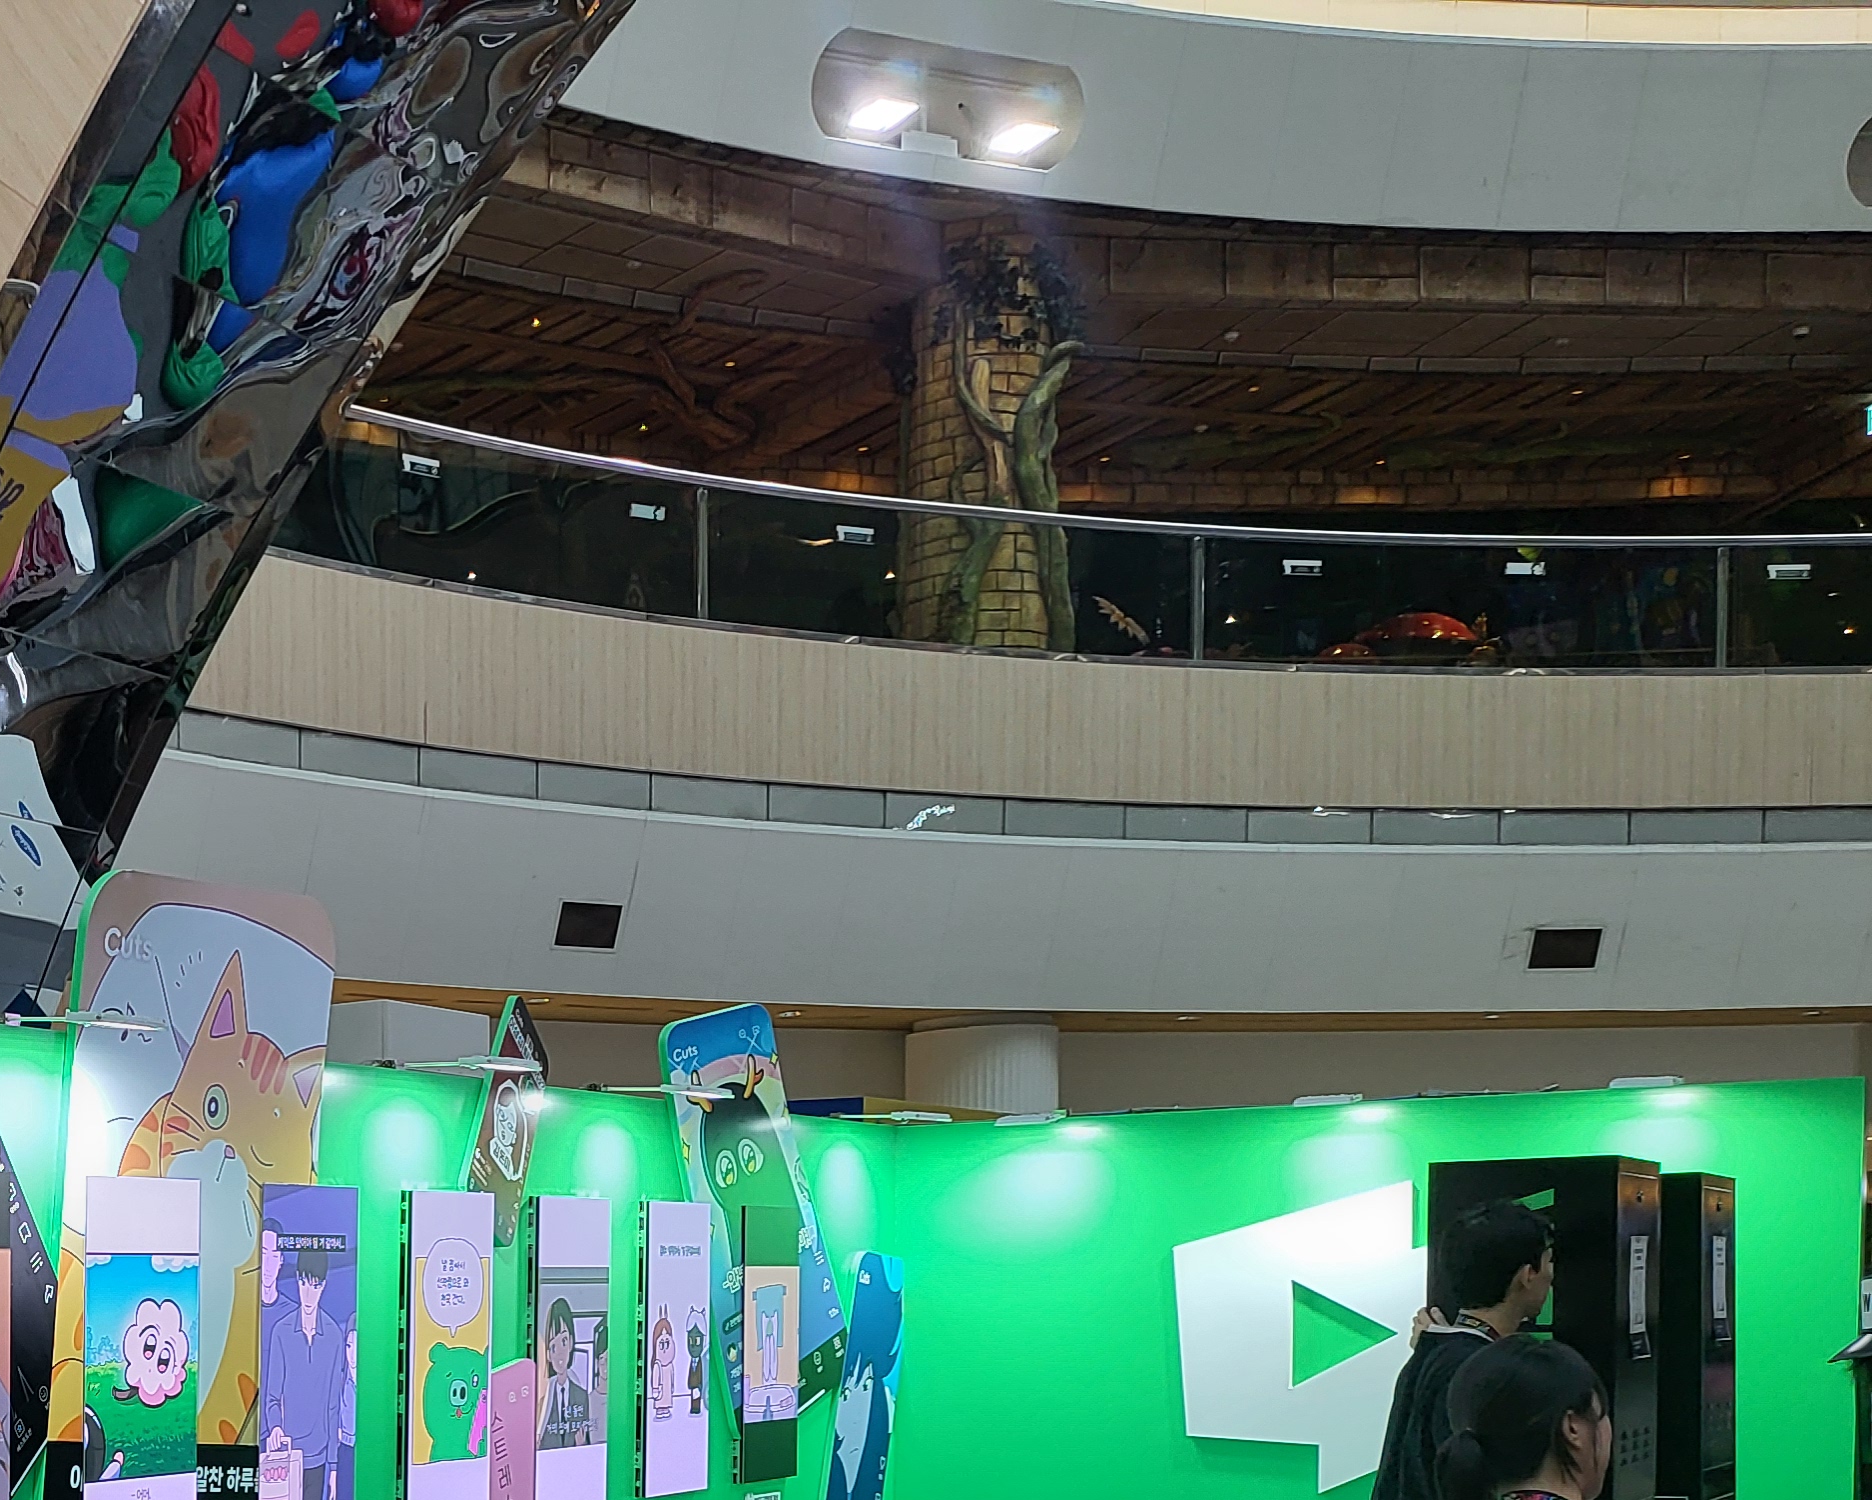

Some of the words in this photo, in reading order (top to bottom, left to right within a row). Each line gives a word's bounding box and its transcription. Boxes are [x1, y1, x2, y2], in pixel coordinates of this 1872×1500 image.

[104, 927, 154, 962] Cuts
[672, 1044, 699, 1062] Cuts
[226, 1465, 259, 1494] 하루
